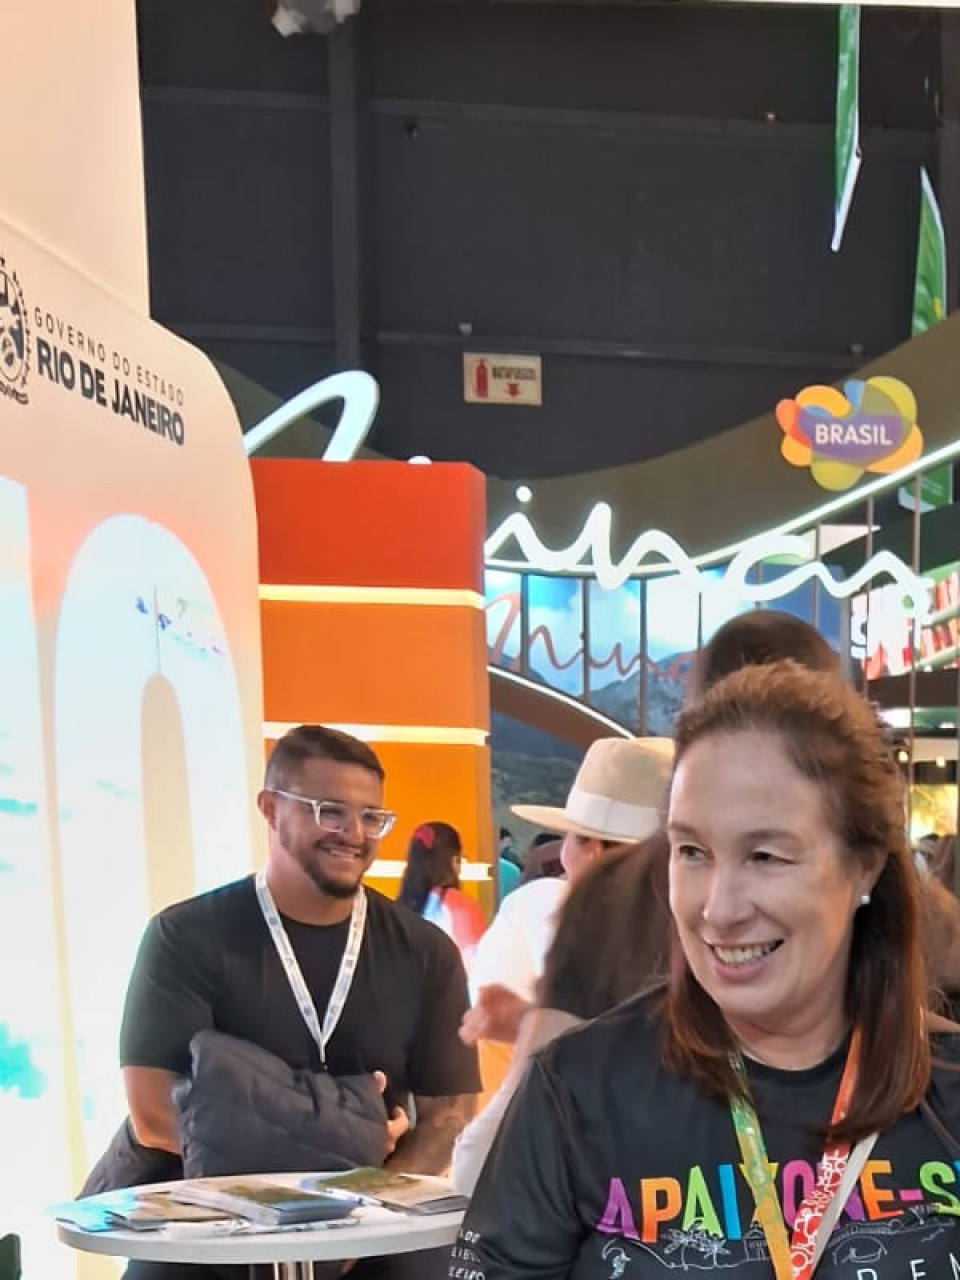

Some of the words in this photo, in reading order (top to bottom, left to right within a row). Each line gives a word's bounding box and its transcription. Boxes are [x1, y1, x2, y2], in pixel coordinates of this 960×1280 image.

[34, 307, 105, 361] GOVERNO
[112, 351, 130, 376] DO
[136, 365, 184, 406] ESTADO
[36, 336, 76, 390] RIO
[79, 360, 107, 407] DE
[111, 379, 185, 446] JANEIRO
[815, 423, 892, 446] BRASIL
